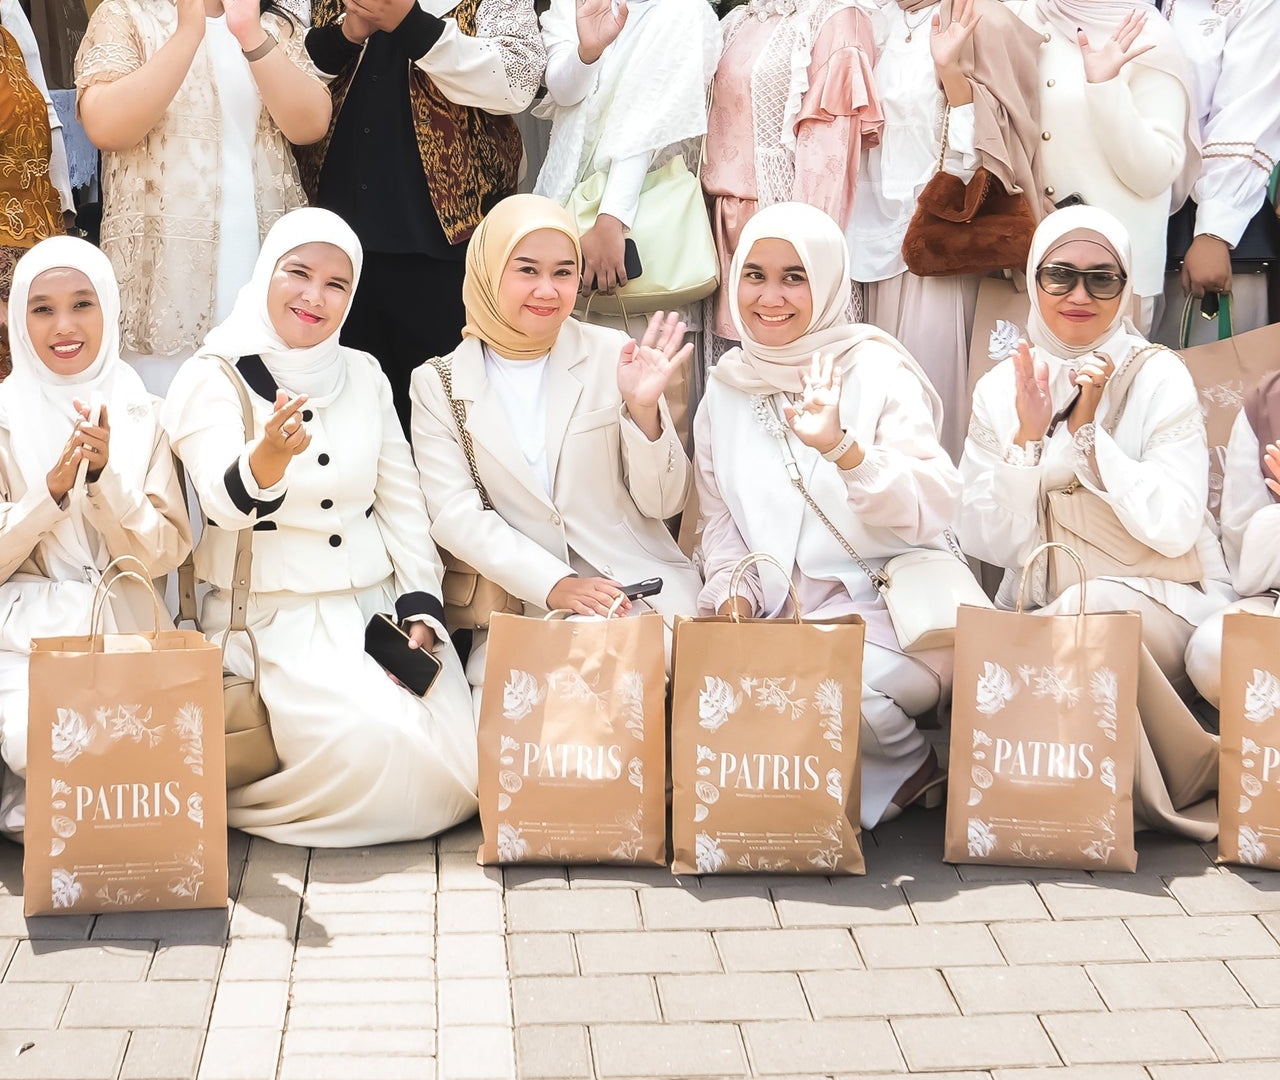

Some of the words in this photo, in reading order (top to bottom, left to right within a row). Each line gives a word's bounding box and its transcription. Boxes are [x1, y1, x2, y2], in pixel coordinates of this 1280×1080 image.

[522, 742, 623, 781] PATRIS
[719, 751, 821, 792] PATRIS
[994, 737, 1095, 780] PATRIS
[75, 780, 182, 822] PATRIS
